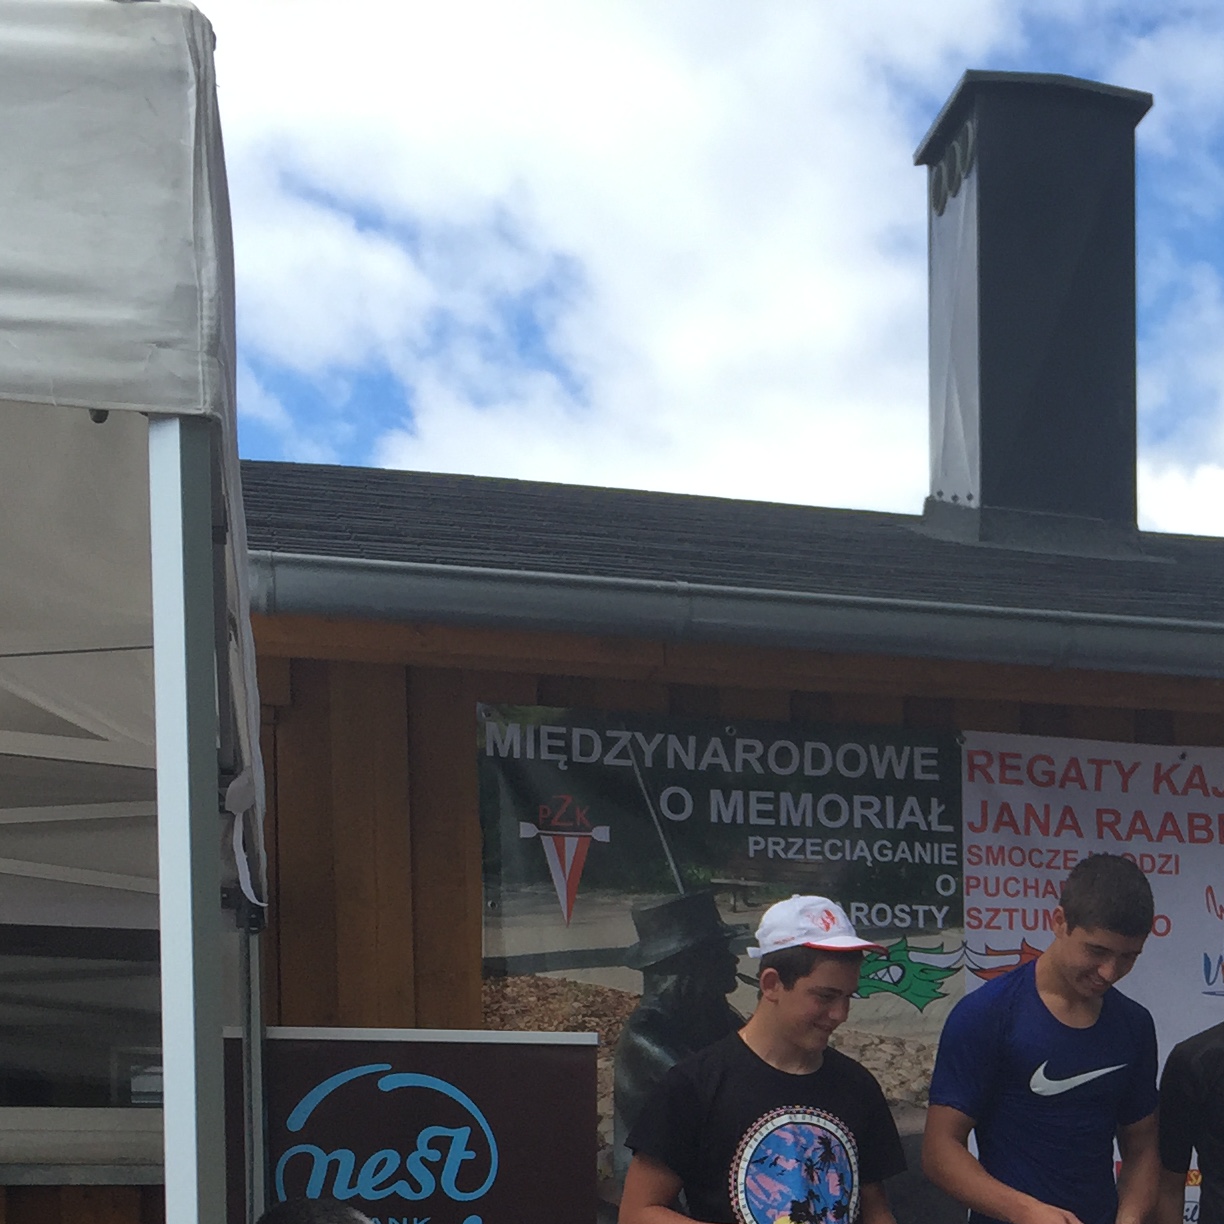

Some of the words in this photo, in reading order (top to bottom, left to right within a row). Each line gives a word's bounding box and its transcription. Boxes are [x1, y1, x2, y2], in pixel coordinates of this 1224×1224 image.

[485, 722, 940, 781] MIĘDZYNARODOWE
[966, 749, 1143, 794] REGATY
[660, 785, 694, 821] O
[709, 790, 955, 832] MEMORIAŁ
[966, 799, 1085, 840] JANA
[747, 835, 959, 867] PRZECIĄGANIE
[935, 873, 957, 897] O
